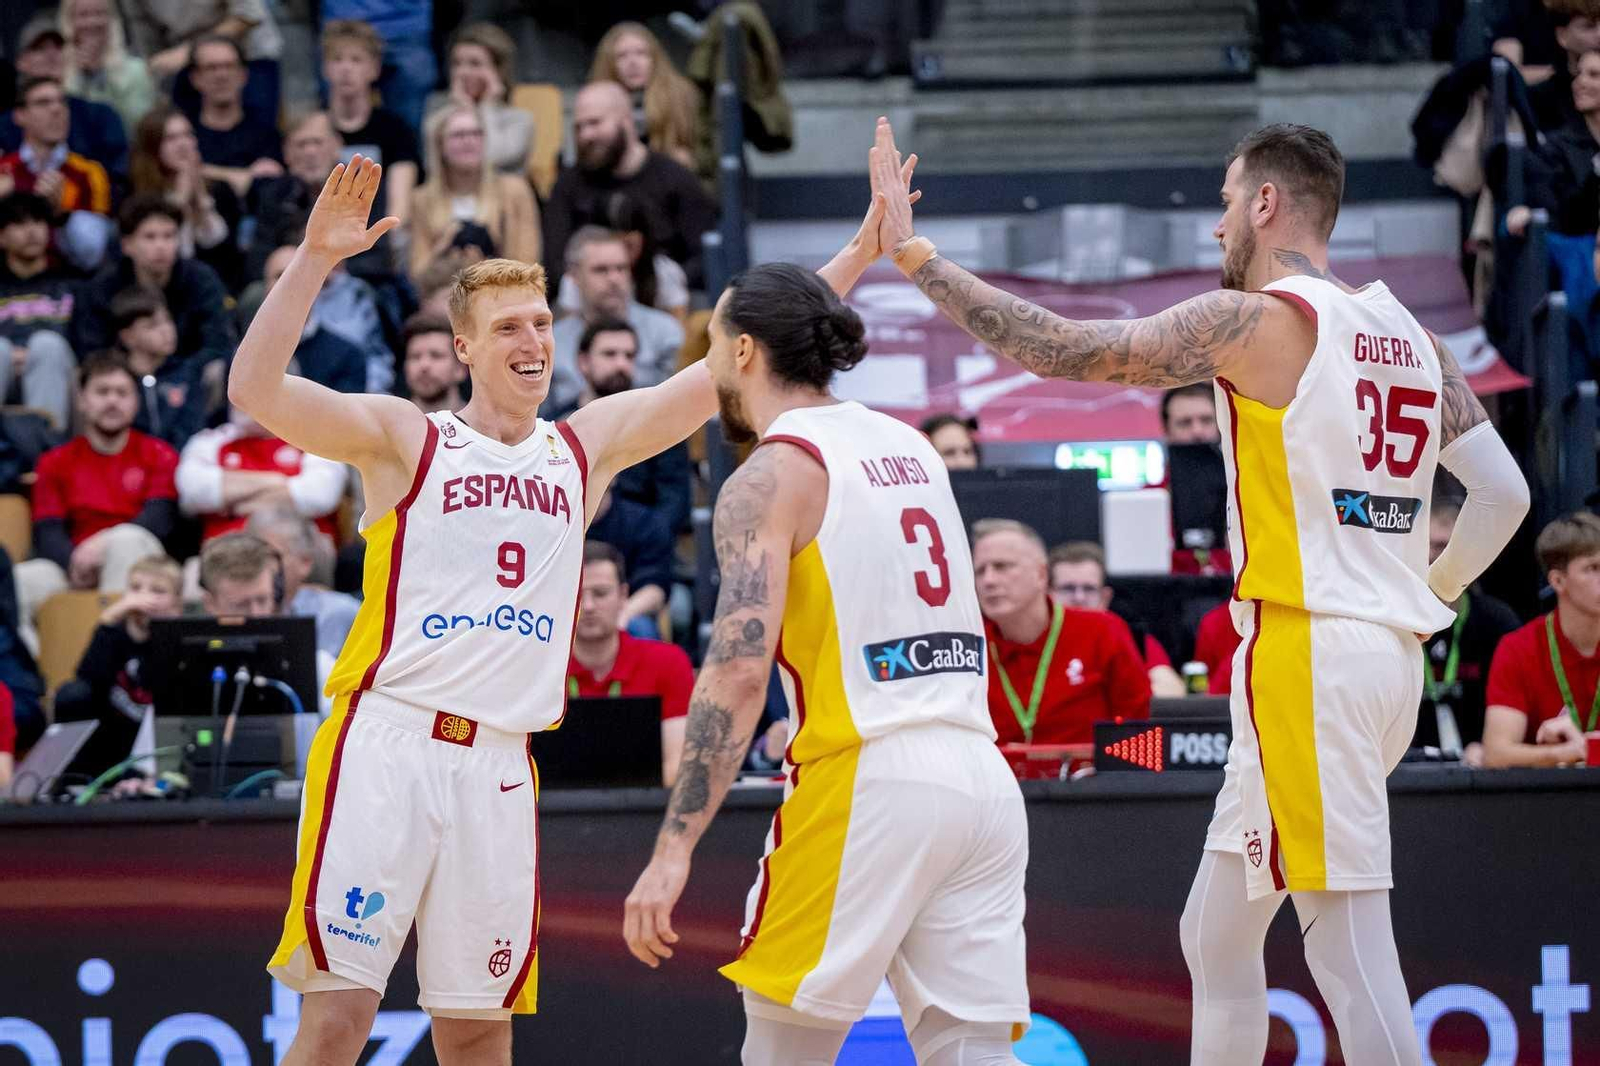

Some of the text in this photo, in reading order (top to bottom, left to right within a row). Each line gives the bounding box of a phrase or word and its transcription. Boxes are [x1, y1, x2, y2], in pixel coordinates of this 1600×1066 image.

[1355, 378, 1437, 478] 35
[860, 456, 930, 487] ALONSO
[443, 474, 571, 525] ESPAÑA
[496, 541, 526, 589] 9
[900, 507, 951, 607] 3
